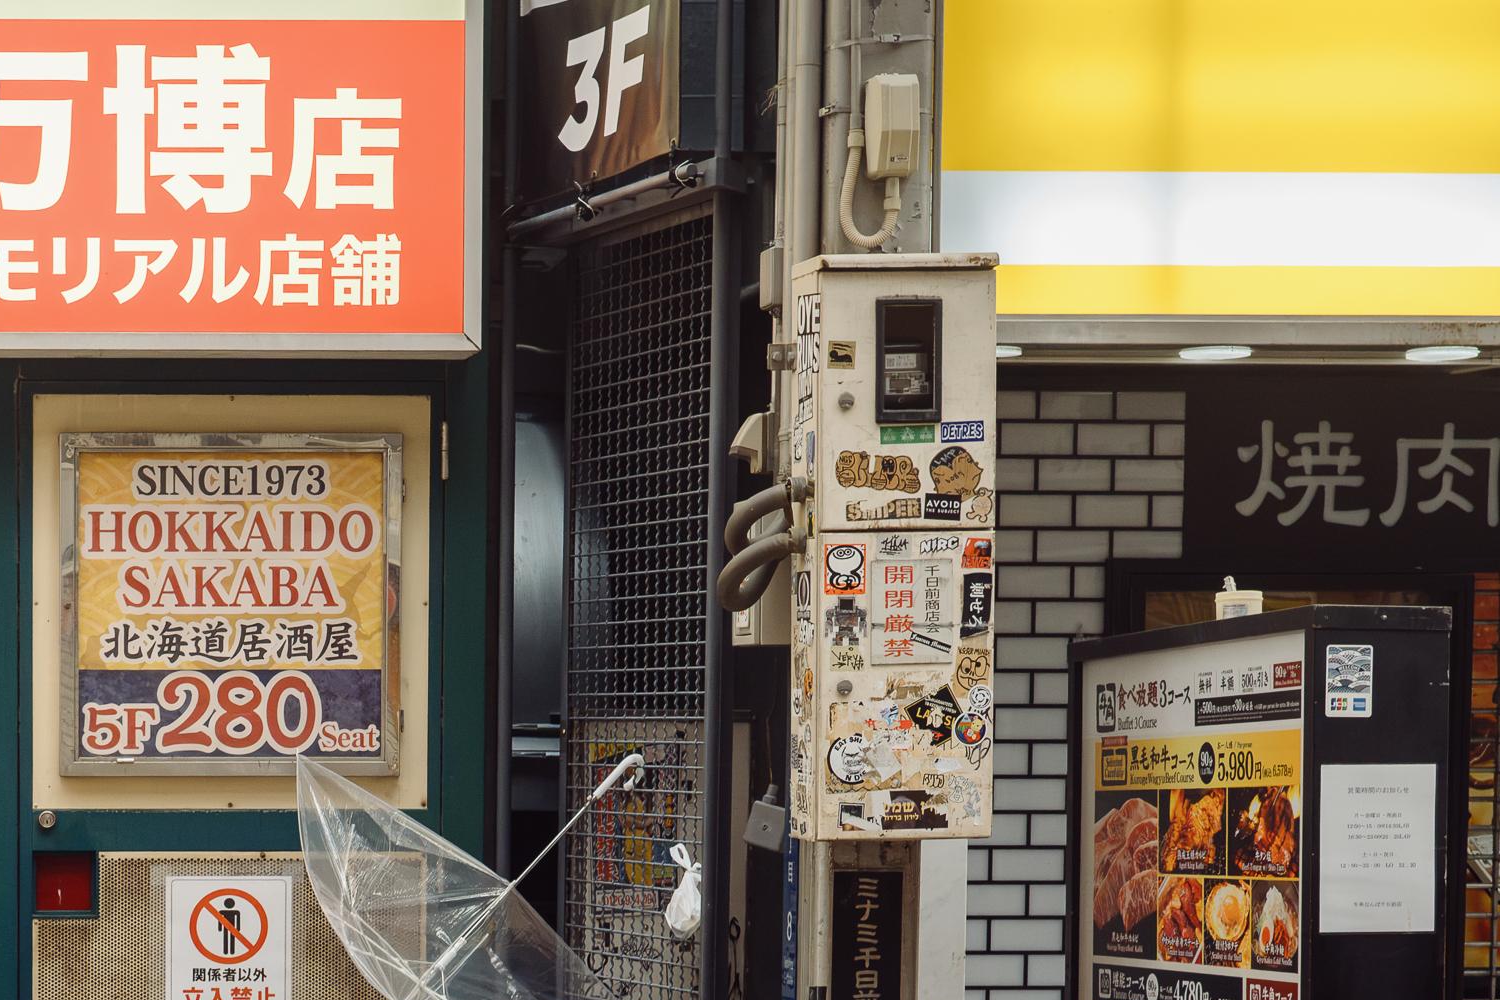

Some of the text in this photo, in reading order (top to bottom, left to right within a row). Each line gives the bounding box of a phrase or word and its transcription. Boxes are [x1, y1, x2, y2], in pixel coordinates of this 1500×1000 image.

[558, 4, 650, 152] 3F
[942, 422, 983, 441] DETRES
[136, 465, 326, 496] SINCE1973
[1235, 420, 1500, 527] 焼肉
[926, 500, 960, 509] AVOID
[88, 510, 374, 553] HOKKAIDO
[122, 565, 338, 607] SAKABA
[925, 565, 940, 633] 千日前商店会
[884, 566, 914, 657] 開閉厳禁
[103, 621, 358, 662] 北海道居酒屋
[88, 675, 377, 750] 5F 280 Seat
[1117, 680, 1192, 710] 食べ放題3コース
[1139, 716, 1157, 730] Course
[1130, 744, 1195, 772] 黒毛和牛コース
[1218, 751, 1262, 781] 5,980円
[192, 968, 266, 982] 関係者以外
